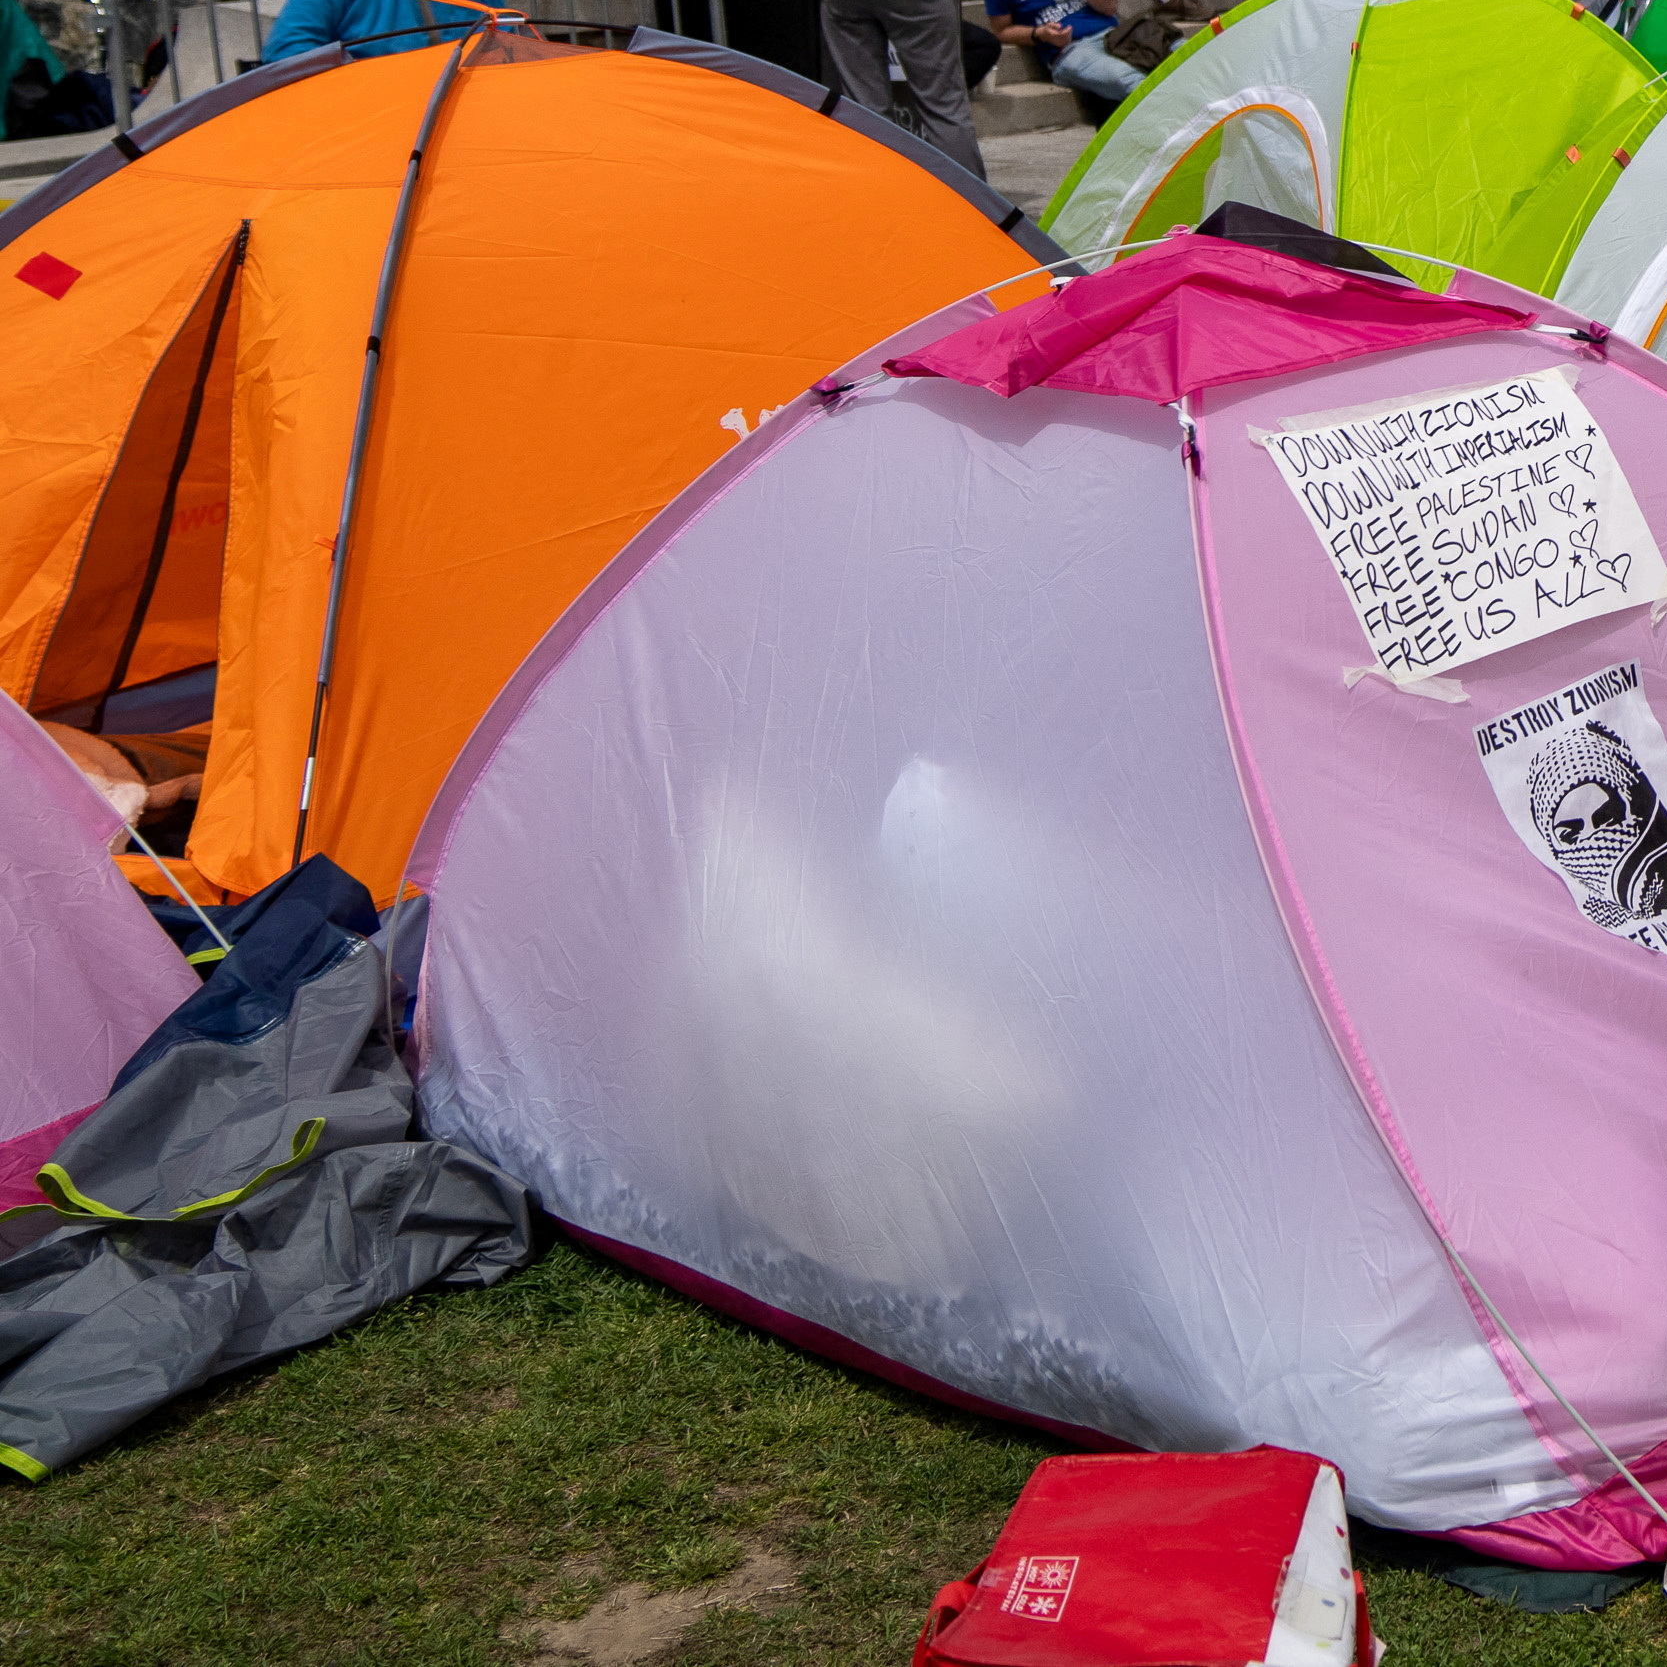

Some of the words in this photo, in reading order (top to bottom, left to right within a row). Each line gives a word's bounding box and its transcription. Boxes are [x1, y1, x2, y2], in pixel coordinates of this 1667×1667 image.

[1277, 420, 1377, 477] DOWN
[1360, 411, 1424, 454] WITH
[1420, 381, 1545, 436] ZIONISM
[1302, 457, 1394, 528] DOWN
[1385, 444, 1442, 490] WITH
[1433, 412, 1571, 474] IMPERIALISM
[1330, 506, 1418, 569] FREE
[1416, 454, 1560, 529] PALESTINE
[1350, 546, 1433, 603] FREE
[1432, 494, 1538, 565] SUDAN
[1364, 585, 1444, 638] FREE
[1450, 538, 1559, 602] CONGO
[1378, 619, 1462, 671] FREE
[1464, 599, 1516, 641] US
[1535, 566, 1605, 618] ALL
[1477, 696, 1564, 756] DESTROY
[1563, 663, 1639, 716] ZIONISM
